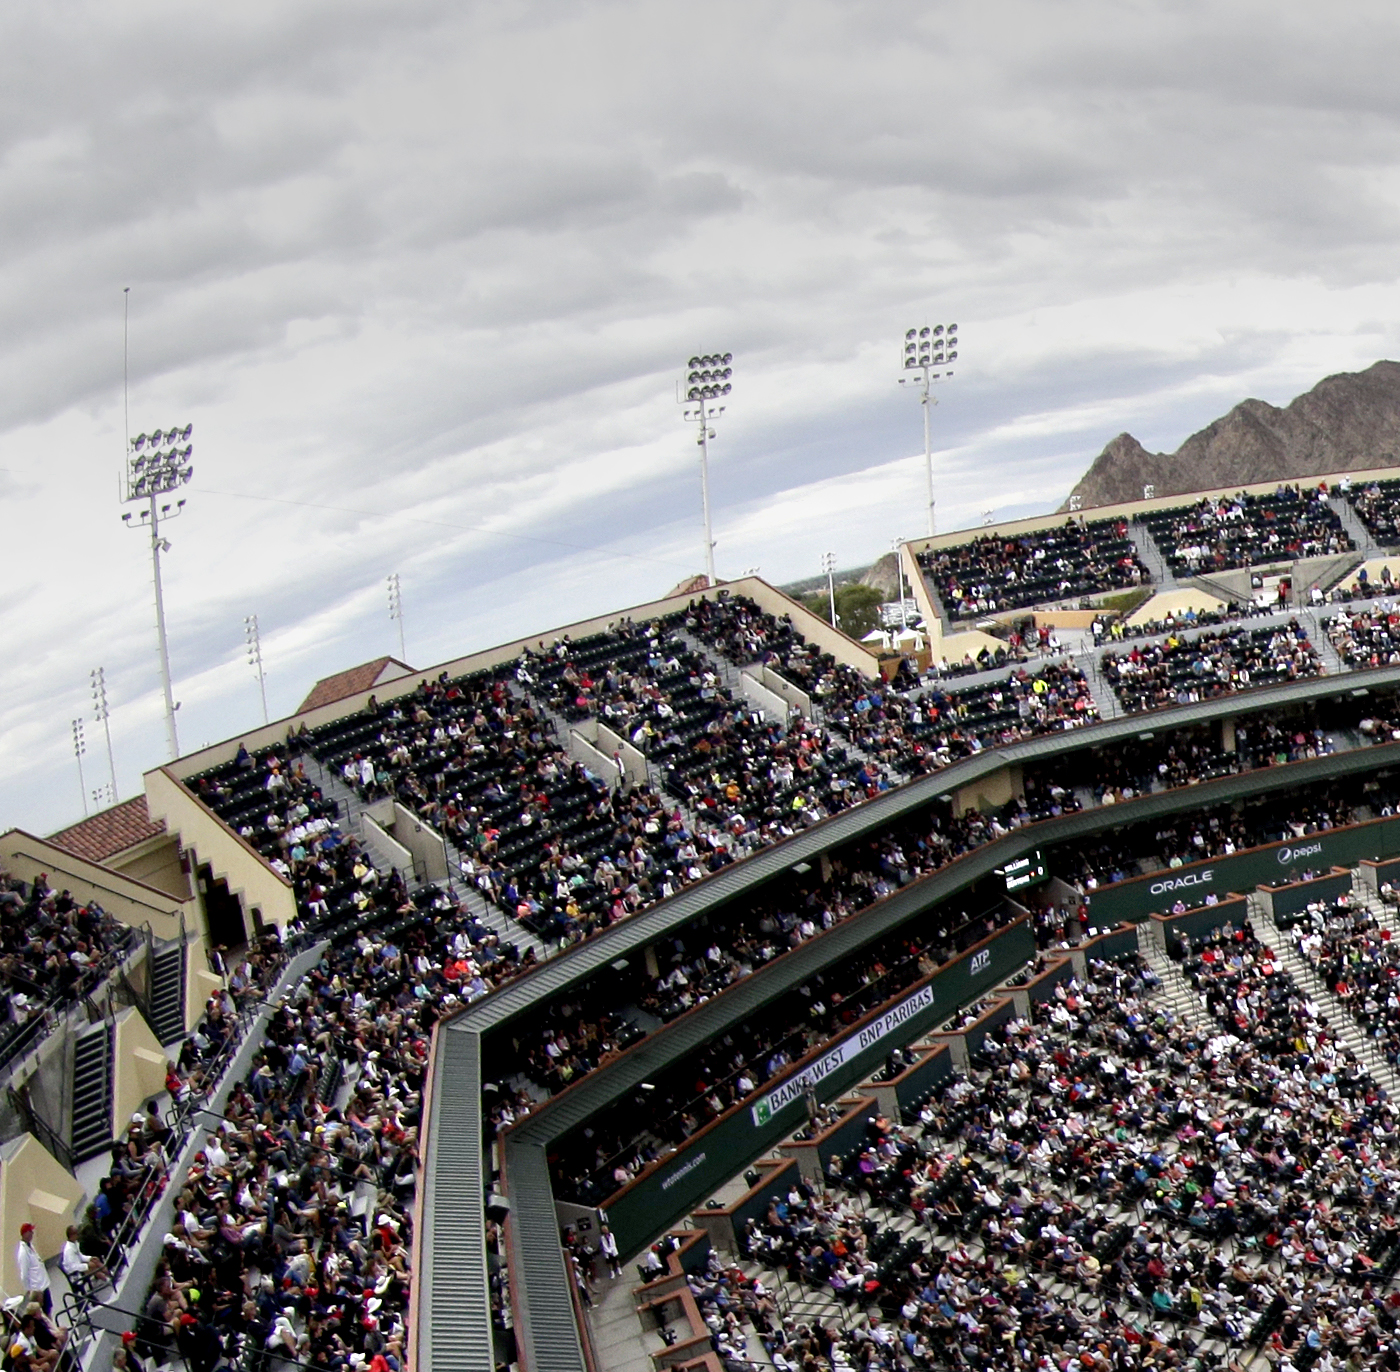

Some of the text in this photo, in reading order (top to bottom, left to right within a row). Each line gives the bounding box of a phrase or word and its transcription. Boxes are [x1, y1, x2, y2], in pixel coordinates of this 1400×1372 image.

[1293, 843, 1322, 860] pepsi
[1150, 869, 1215, 895] ORACLE
[971, 949, 990, 971] ATP
[770, 1078, 805, 1111] BANK
[812, 1048, 845, 1081] WEST
[859, 1024, 883, 1048] BNP
[885, 988, 932, 1031] PARIBAS
